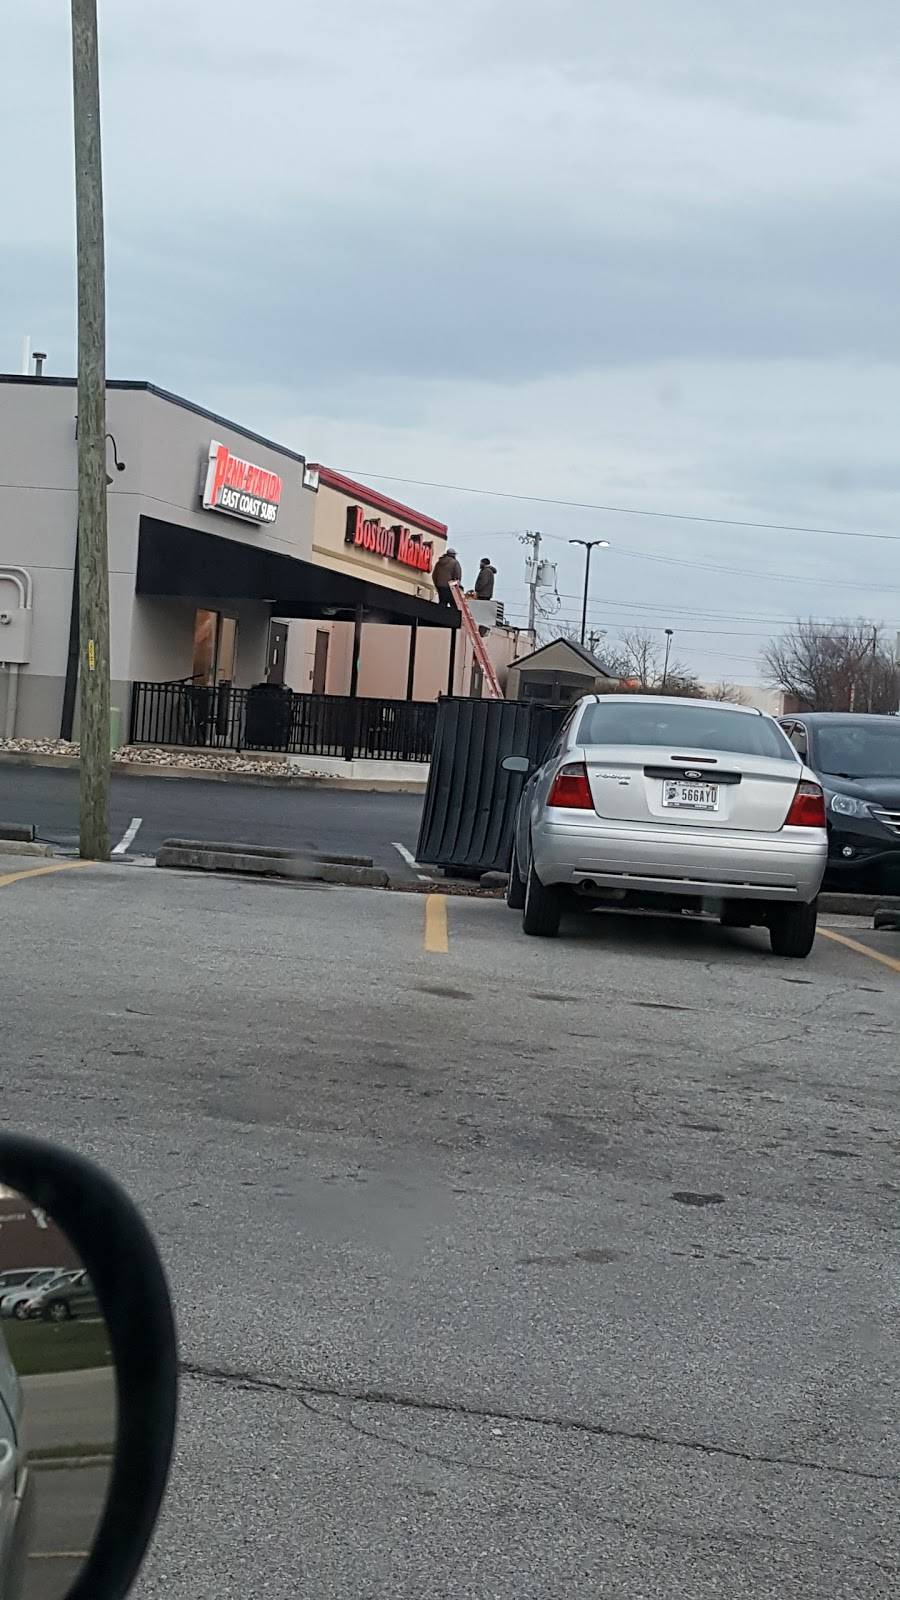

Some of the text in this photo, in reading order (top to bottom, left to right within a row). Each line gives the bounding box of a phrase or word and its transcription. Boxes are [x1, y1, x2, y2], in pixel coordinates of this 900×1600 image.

[221, 488, 277, 521] EAST COAST SUBS
[351, 506, 433, 573] Boston Market
[681, 788, 717, 803] 566AYU
